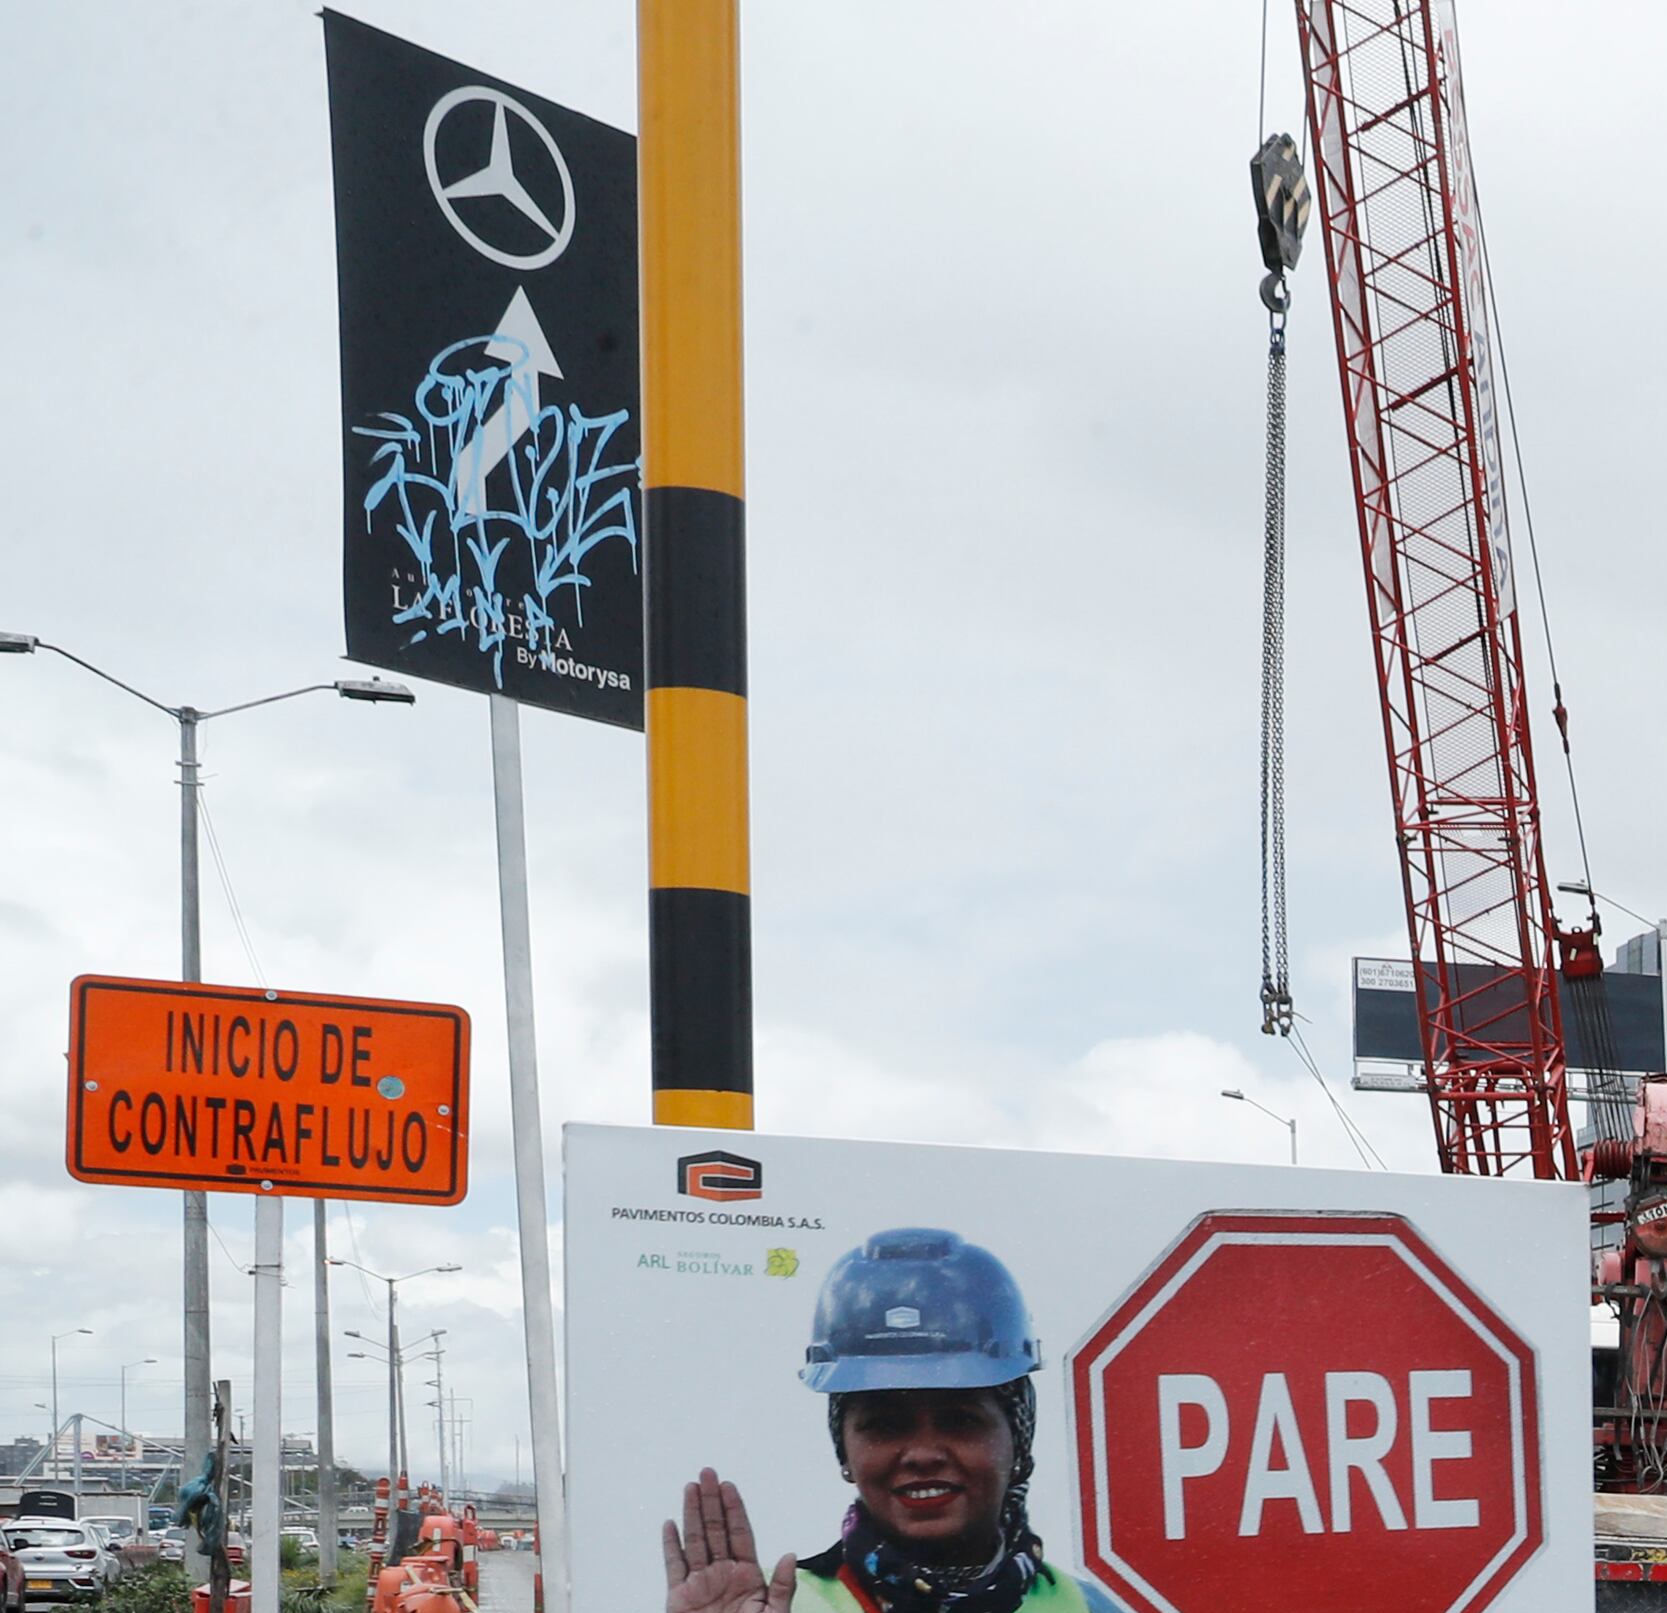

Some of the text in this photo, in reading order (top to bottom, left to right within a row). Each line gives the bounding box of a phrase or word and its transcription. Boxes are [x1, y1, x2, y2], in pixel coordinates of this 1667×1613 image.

[516, 647, 632, 691] By Motorysa
[166, 1010, 373, 1087] INICIO DE
[109, 1090, 428, 1173] CONTRAFLUJO
[612, 1207, 826, 1230] PAVIMENTOS COLOMBIA S.A.S.
[637, 1253, 671, 1269] ARL
[677, 1259, 754, 1276] BOLÍVAR
[1158, 1369, 1480, 1540] PARE
